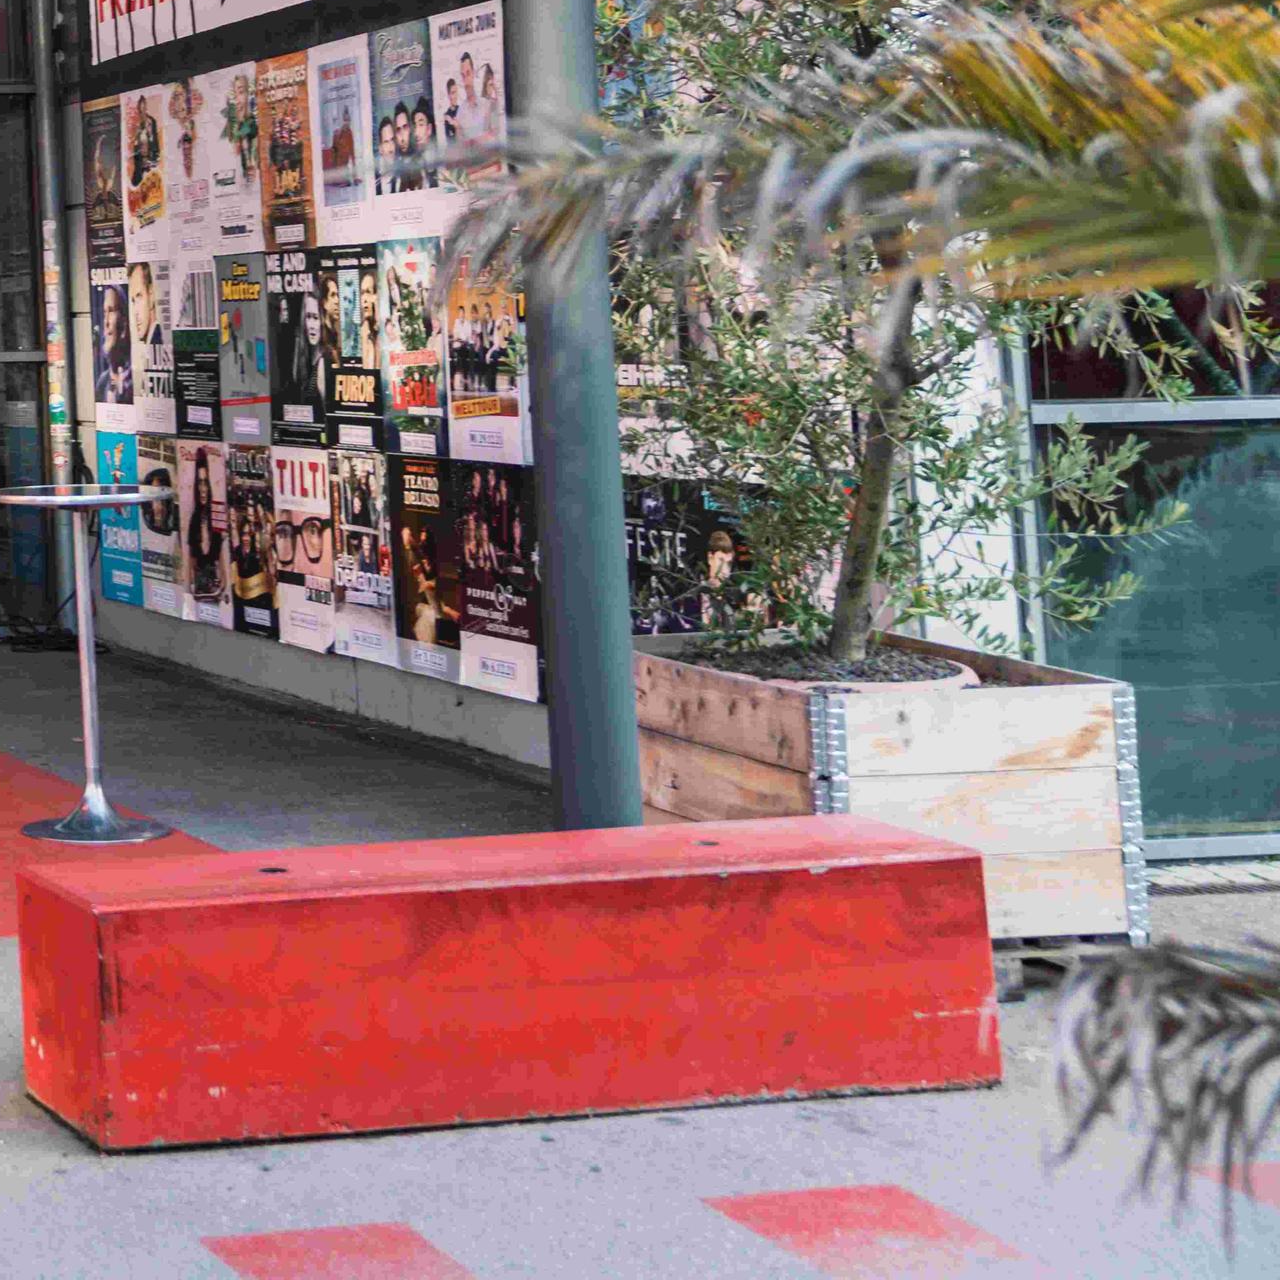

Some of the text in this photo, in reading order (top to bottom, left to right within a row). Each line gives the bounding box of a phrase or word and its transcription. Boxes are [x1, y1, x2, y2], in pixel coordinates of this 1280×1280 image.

[283, 252, 306, 271] AND
[221, 279, 262, 302] Mütter
[285, 272, 314, 293] CASH
[334, 375, 376, 403] FUROR
[276, 459, 328, 499] TILT!
